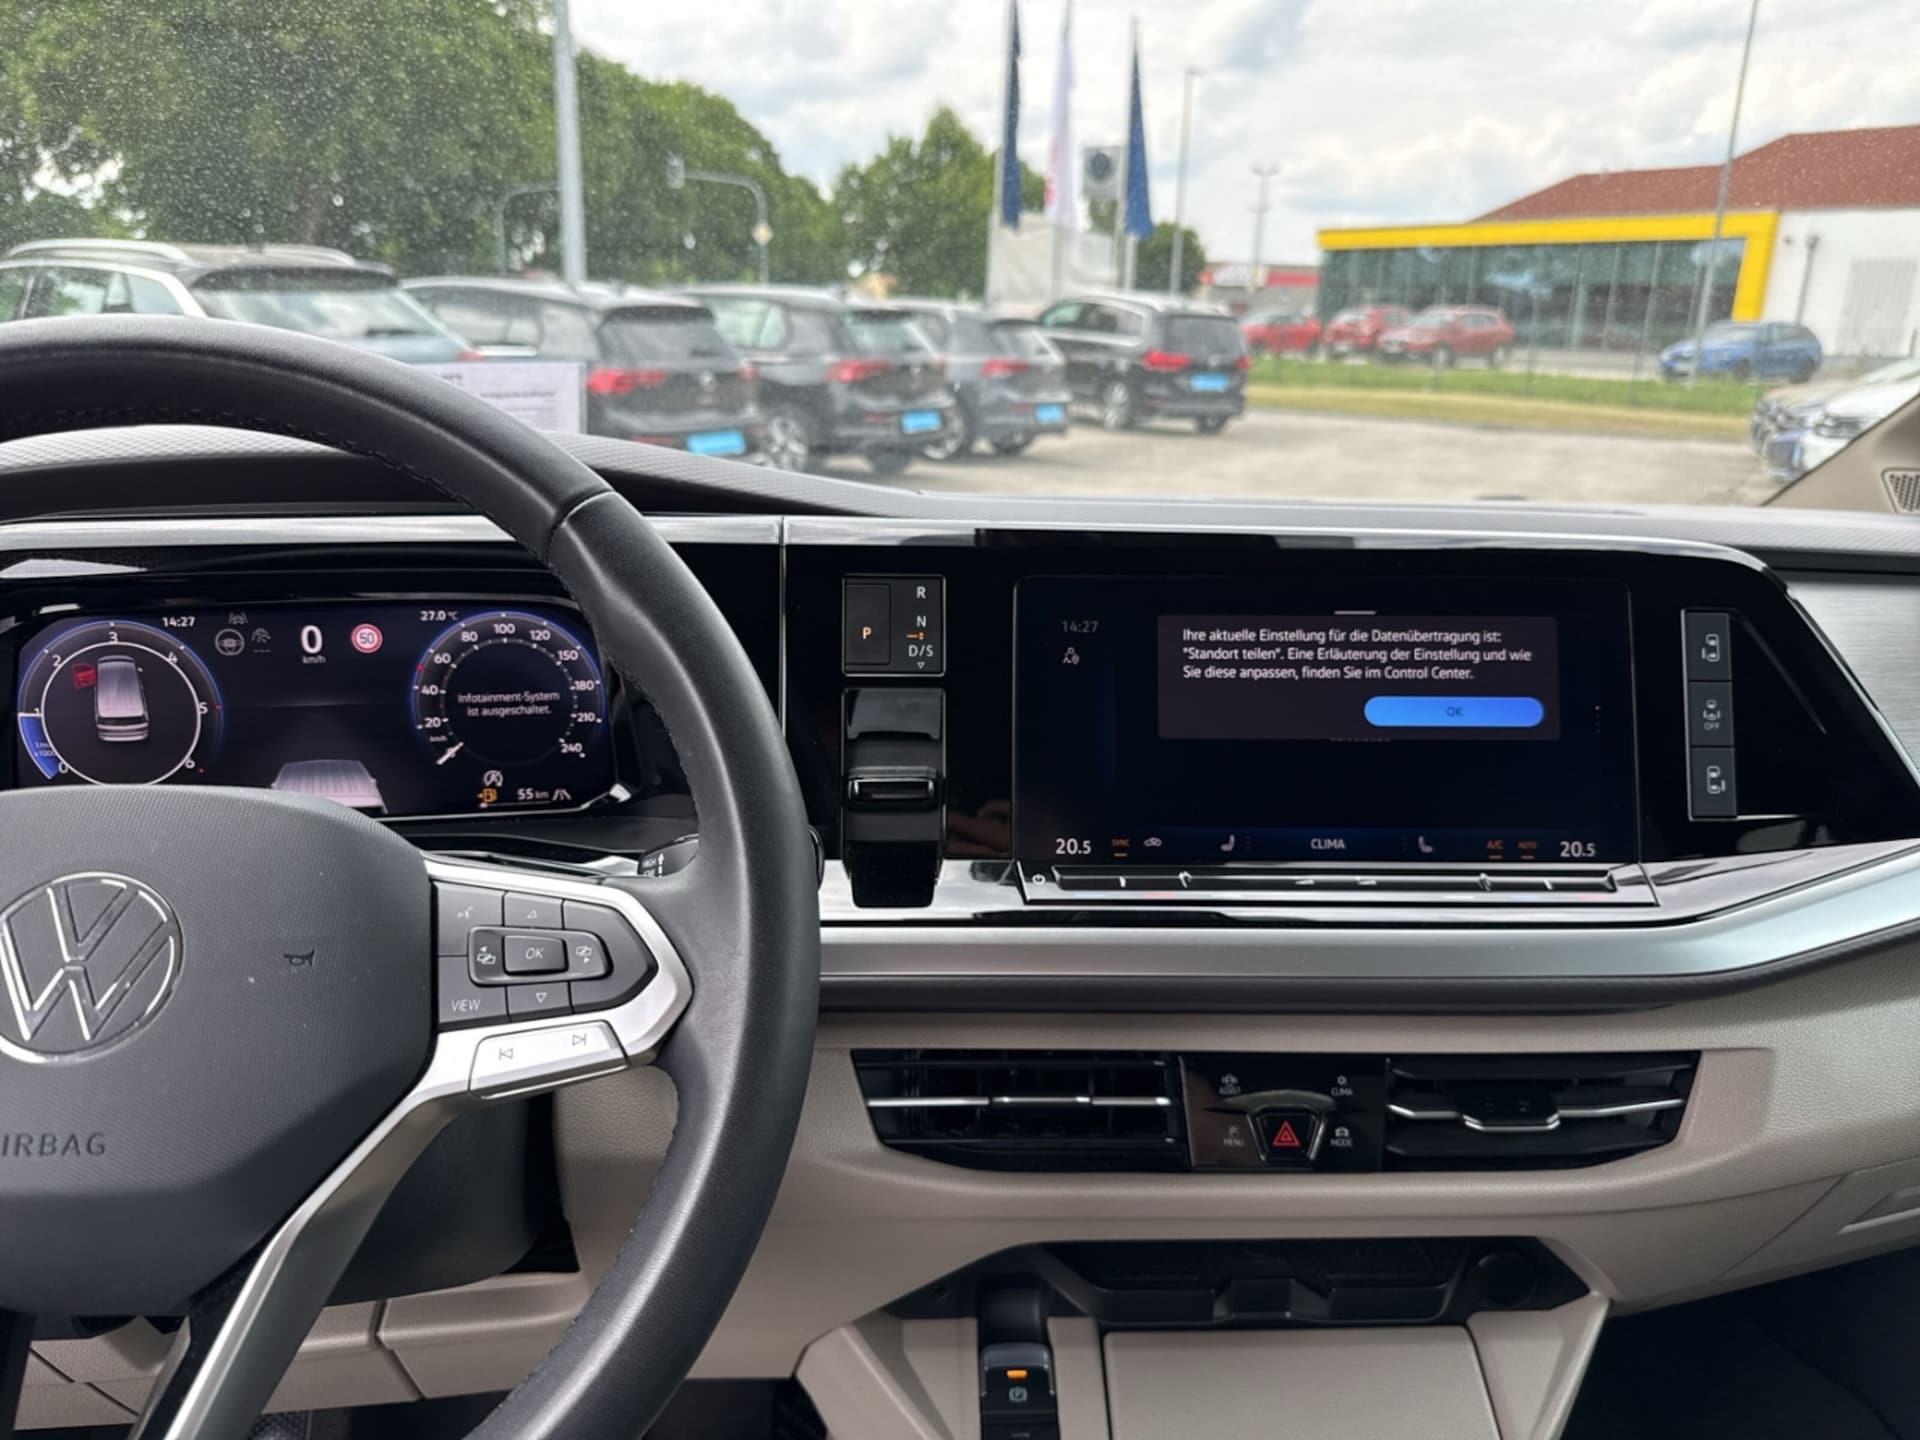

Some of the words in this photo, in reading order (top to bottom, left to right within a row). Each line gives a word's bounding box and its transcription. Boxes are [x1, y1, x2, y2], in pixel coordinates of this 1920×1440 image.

[916, 585, 926, 599] R
[162, 616, 195, 627] 14:27
[420, 610, 446, 621] 27.0
[916, 615, 927, 627] N
[493, 623, 516, 635] 100
[862, 626, 873, 640] P
[1062, 620, 1099, 633] 14:27
[107, 631, 119, 644] 3
[301, 624, 323, 654] 0
[359, 631, 376, 645] 50
[461, 631, 479, 643] 80
[530, 629, 552, 641] 120
[1182, 628, 1206, 642] Ihre
[1209, 628, 1256, 642] aktuelle
[1259, 628, 1326, 645] Einstellung
[1328, 628, 1346, 642] für
[1349, 629, 1369, 642] die
[1371, 629, 1480, 645] Datenübertragung
[1482, 630, 1502, 643] ist:
[557, 649, 579, 662] 150
[908, 643, 934, 658] D/S
[1287, 647, 1314, 661] Eine
[1317, 647, 1387, 663] Erläuterung
[1390, 648, 1410, 661] der
[1413, 647, 1480, 664] Einstellung
[1483, 648, 1506, 661] und
[1509, 649, 1533, 662] wie
[52, 654, 62, 668] 2
[168, 652, 179, 664] 4
[433, 652, 452, 665] 60
[1183, 665, 1202, 678] Sie
[1204, 665, 1237, 679] diese
[1239, 668, 1299, 681] anpassen,
[1301, 665, 1341, 679] finden
[1343, 666, 1362, 679] Sie
[1365, 667, 1381, 679] im
[1384, 666, 1428, 680] Control
[1431, 666, 1474, 680] Center.
[420, 684, 439, 696] 40
[574, 681, 595, 692] 180
[457, 690, 560, 704] Infotainment-System
[198, 702, 209, 714] 5
[467, 707, 480, 717] ist
[1446, 706, 1464, 718] OK
[424, 716, 442, 728] 20
[576, 712, 596, 724] 210
[1703, 721, 1720, 731] OFF
[560, 742, 583, 754] 240
[57, 761, 69, 774] 0
[185, 756, 196, 769] 6
[516, 787, 535, 800] 55
[535, 789, 550, 799] km
[1055, 838, 1091, 855] 20.5
[1310, 838, 1346, 850] CLIMA
[1560, 840, 1596, 858] 20.5
[525, 947, 544, 960] OK
[450, 999, 481, 1013] VIEW
